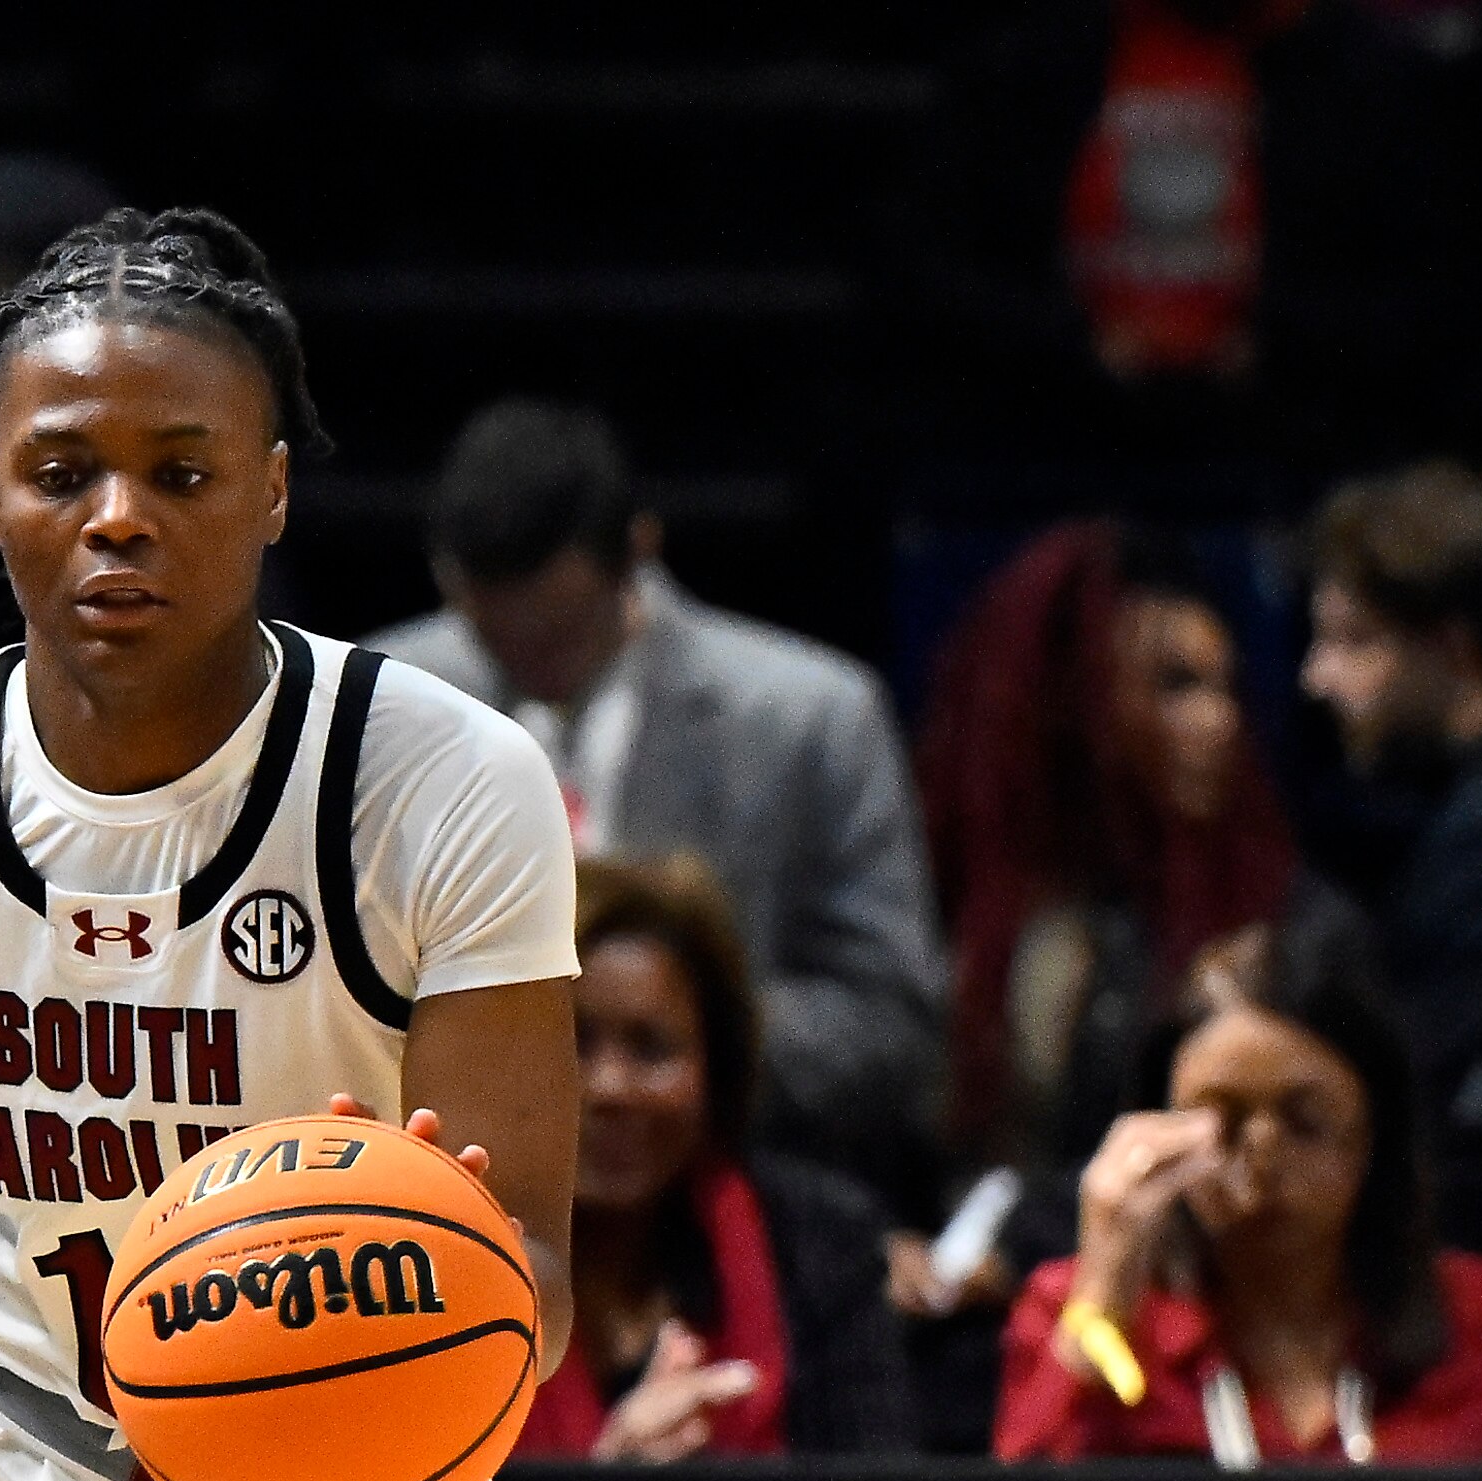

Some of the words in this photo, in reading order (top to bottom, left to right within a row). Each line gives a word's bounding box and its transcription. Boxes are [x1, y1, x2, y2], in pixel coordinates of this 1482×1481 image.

[230, 897, 306, 977] SEC
[191, 1137, 367, 1203] EVO
[148, 1239, 445, 1342] Wilson
